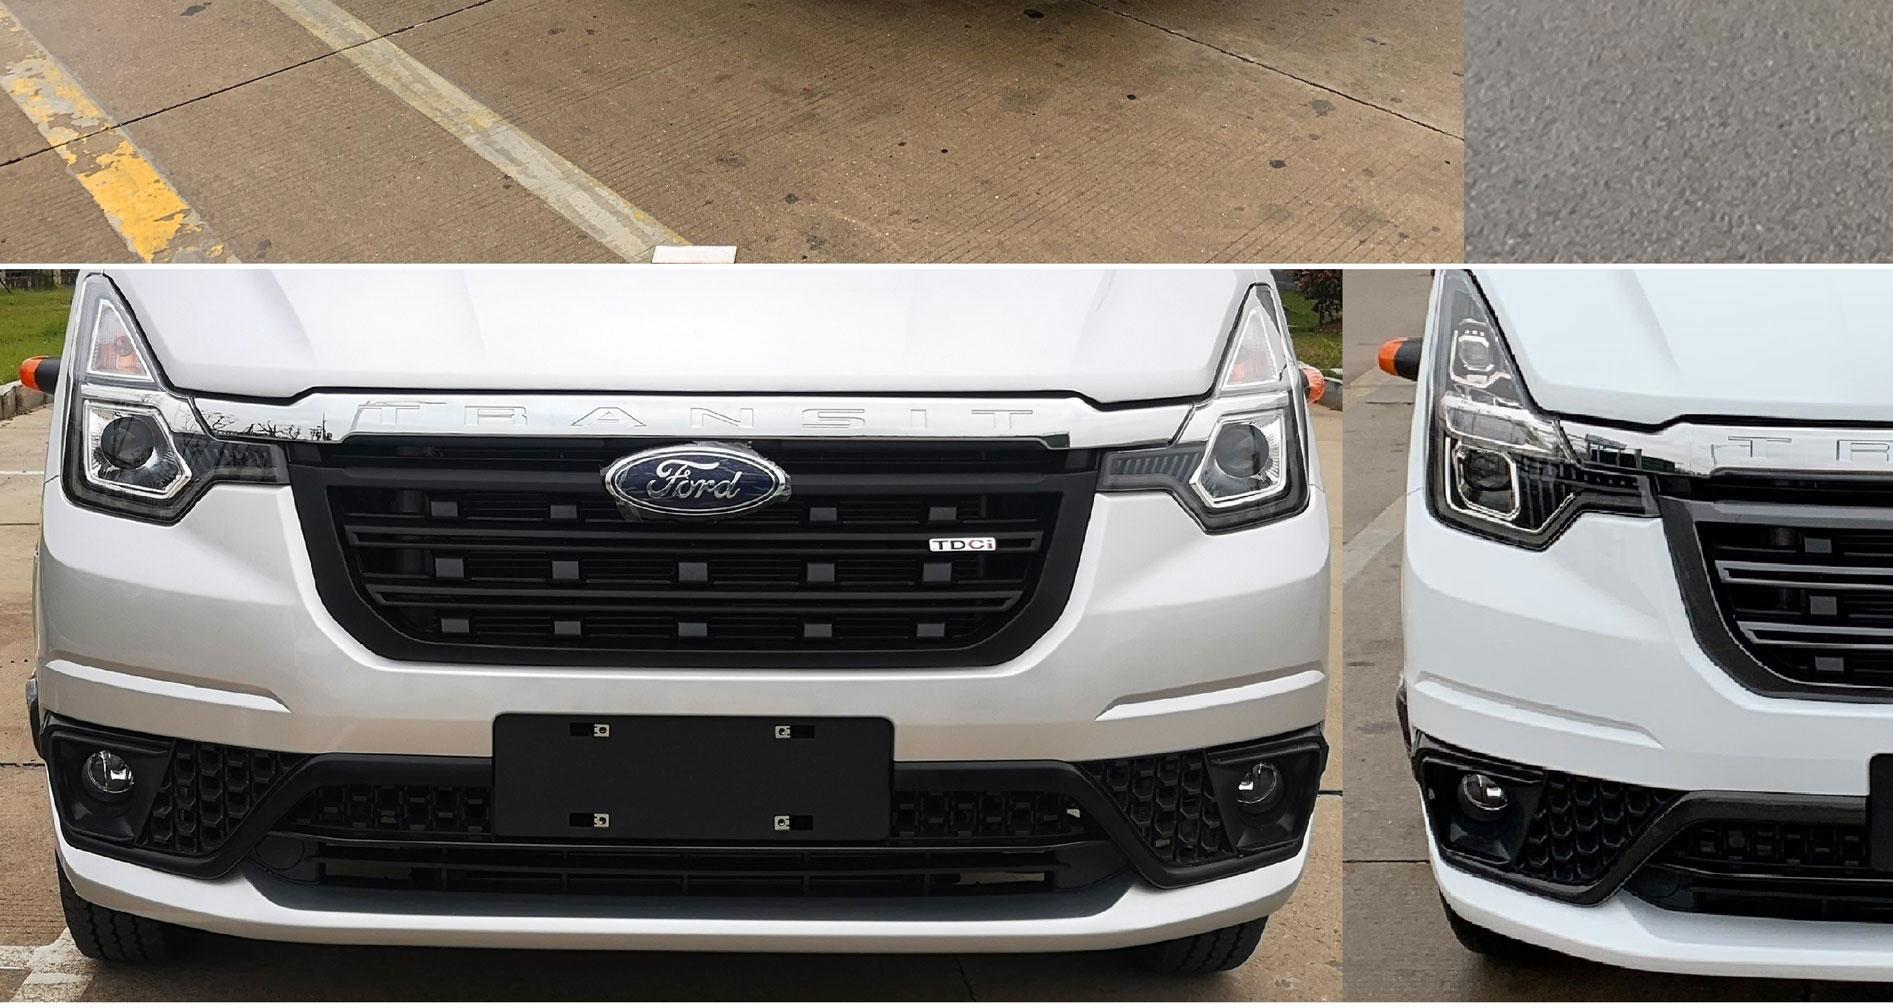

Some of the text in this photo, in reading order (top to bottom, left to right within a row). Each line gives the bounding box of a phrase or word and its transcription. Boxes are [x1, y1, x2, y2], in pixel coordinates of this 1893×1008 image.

[360, 403, 1034, 429] TRANSIT
[647, 458, 743, 500] Ford
[932, 538, 995, 552] TDCi
